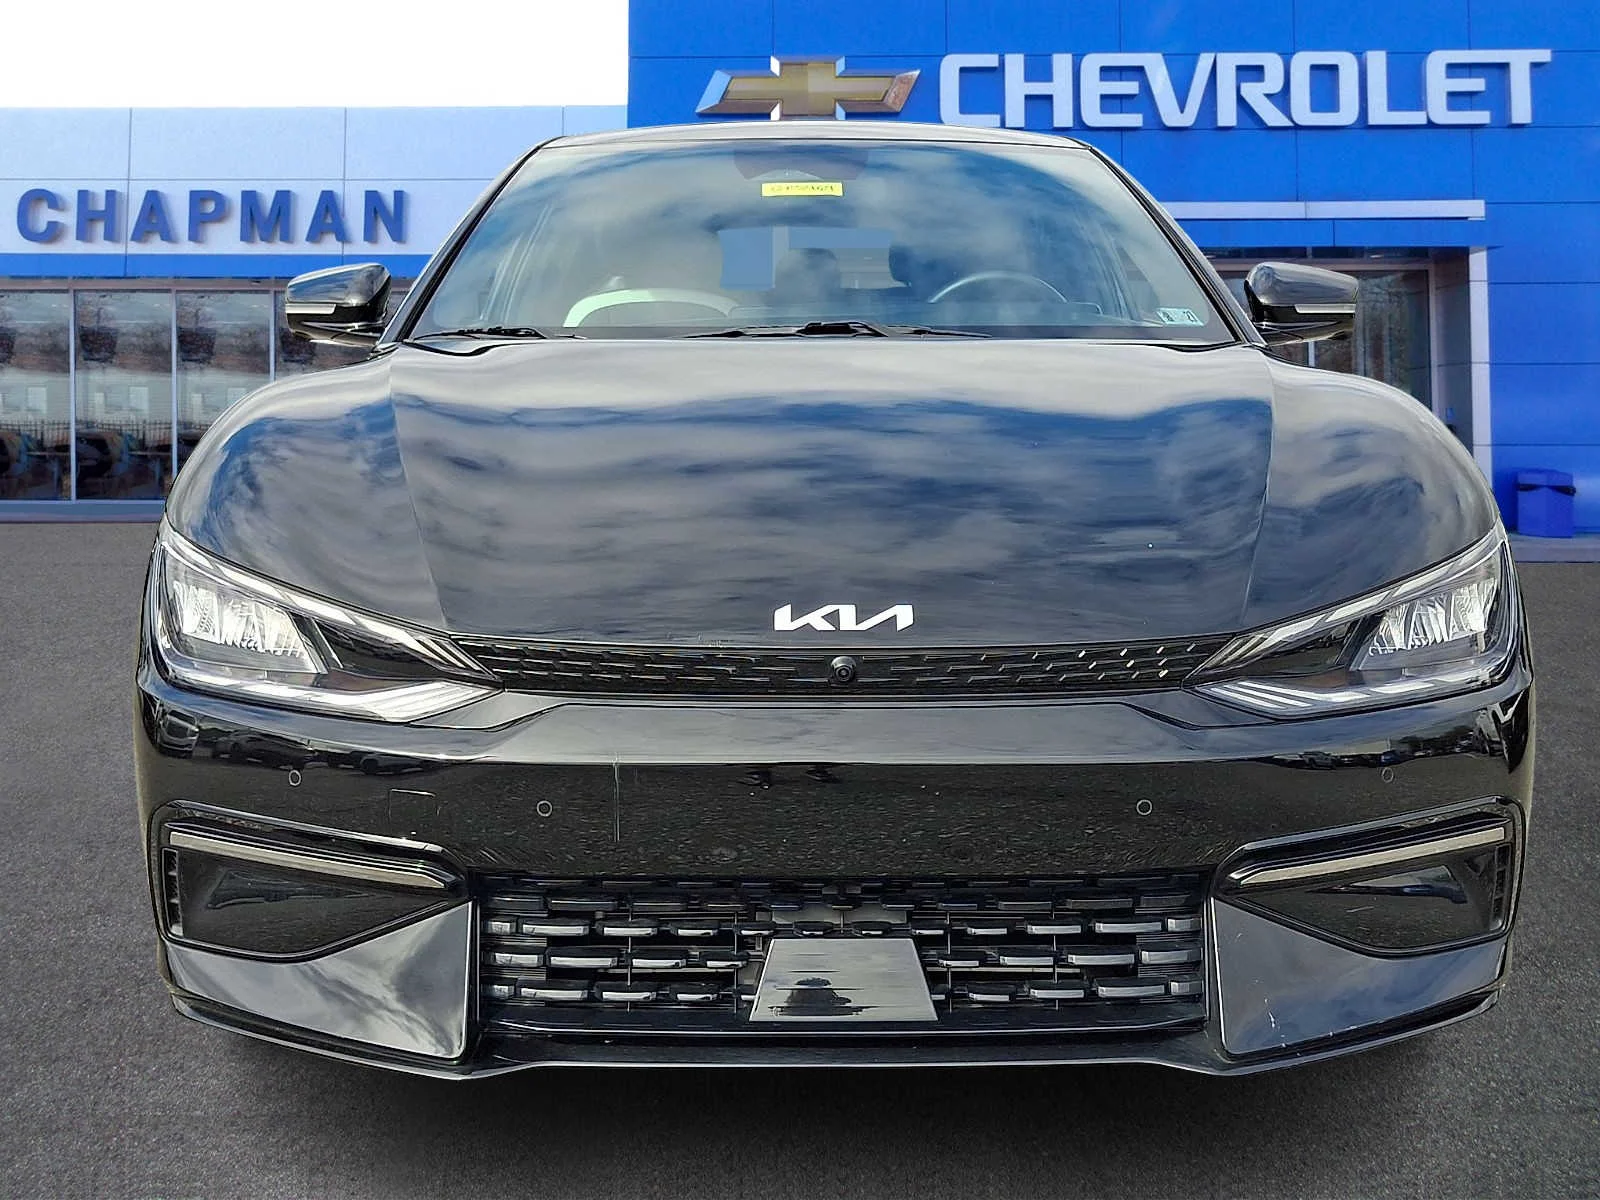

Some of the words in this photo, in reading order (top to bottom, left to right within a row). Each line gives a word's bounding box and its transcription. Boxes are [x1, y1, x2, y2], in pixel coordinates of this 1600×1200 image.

[939, 49, 1552, 128] CHEVROLET
[16, 188, 407, 243] CHAPMAN
[774, 603, 914, 632] KIA
